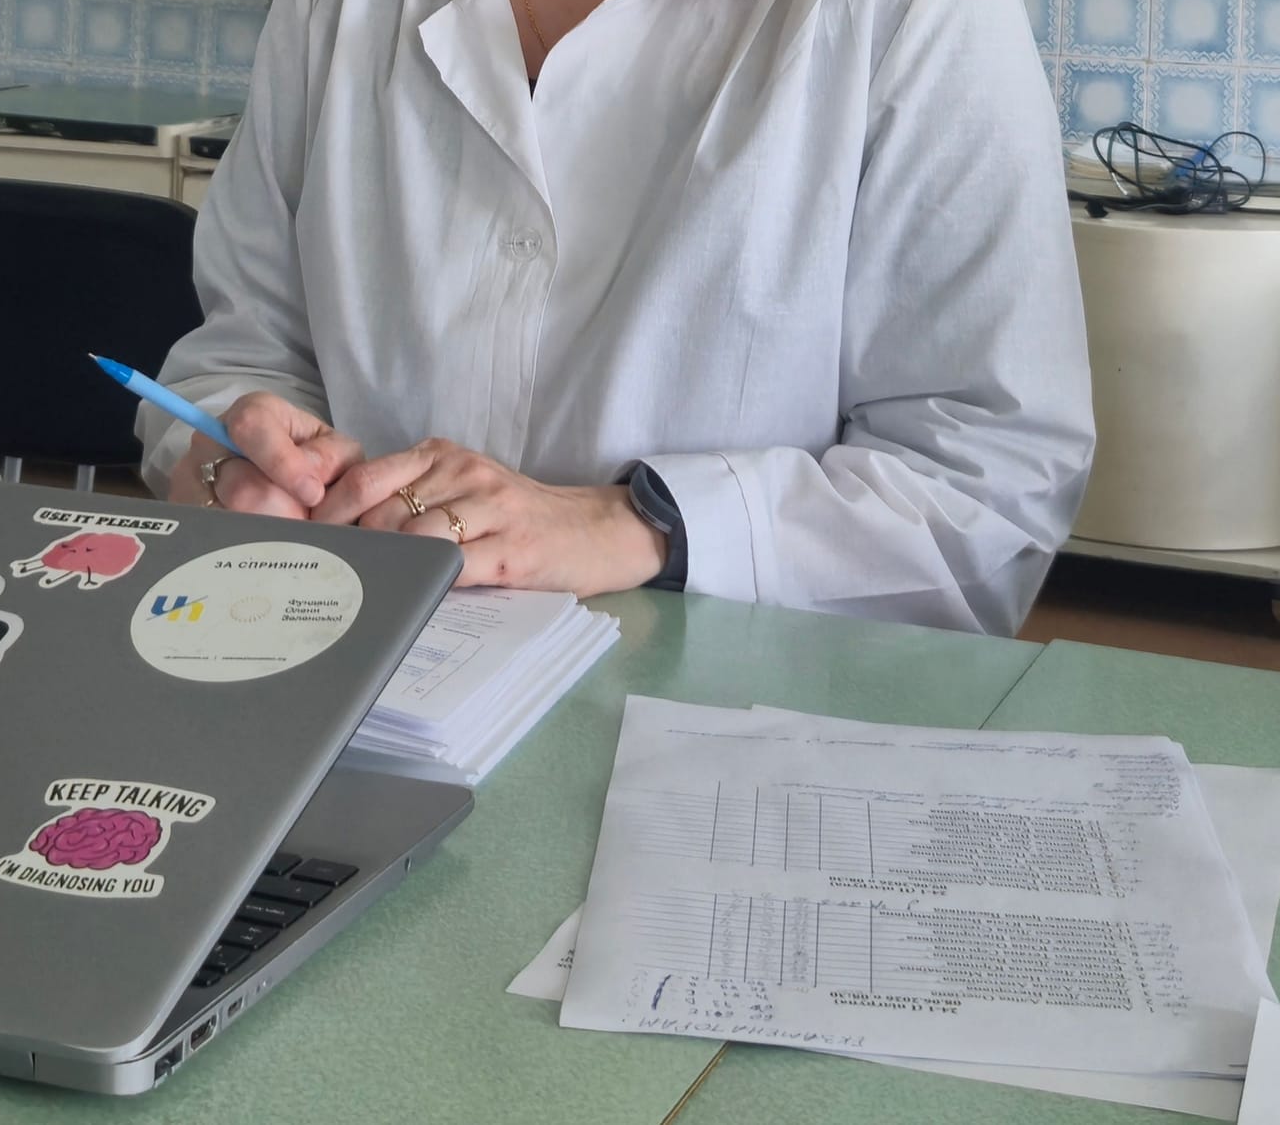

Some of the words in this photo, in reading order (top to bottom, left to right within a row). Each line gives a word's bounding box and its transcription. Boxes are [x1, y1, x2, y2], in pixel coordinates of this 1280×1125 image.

[39, 510, 71, 522] USE
[73, 514, 94, 524] IT
[214, 561, 232, 570] ЗА
[238, 561, 319, 570] СПРИЯННЯ
[49, 783, 110, 801] KEEP
[113, 785, 208, 819] TALKING
[18, 866, 117, 893] DIAGNOSING
[122, 878, 156, 894] YOU
